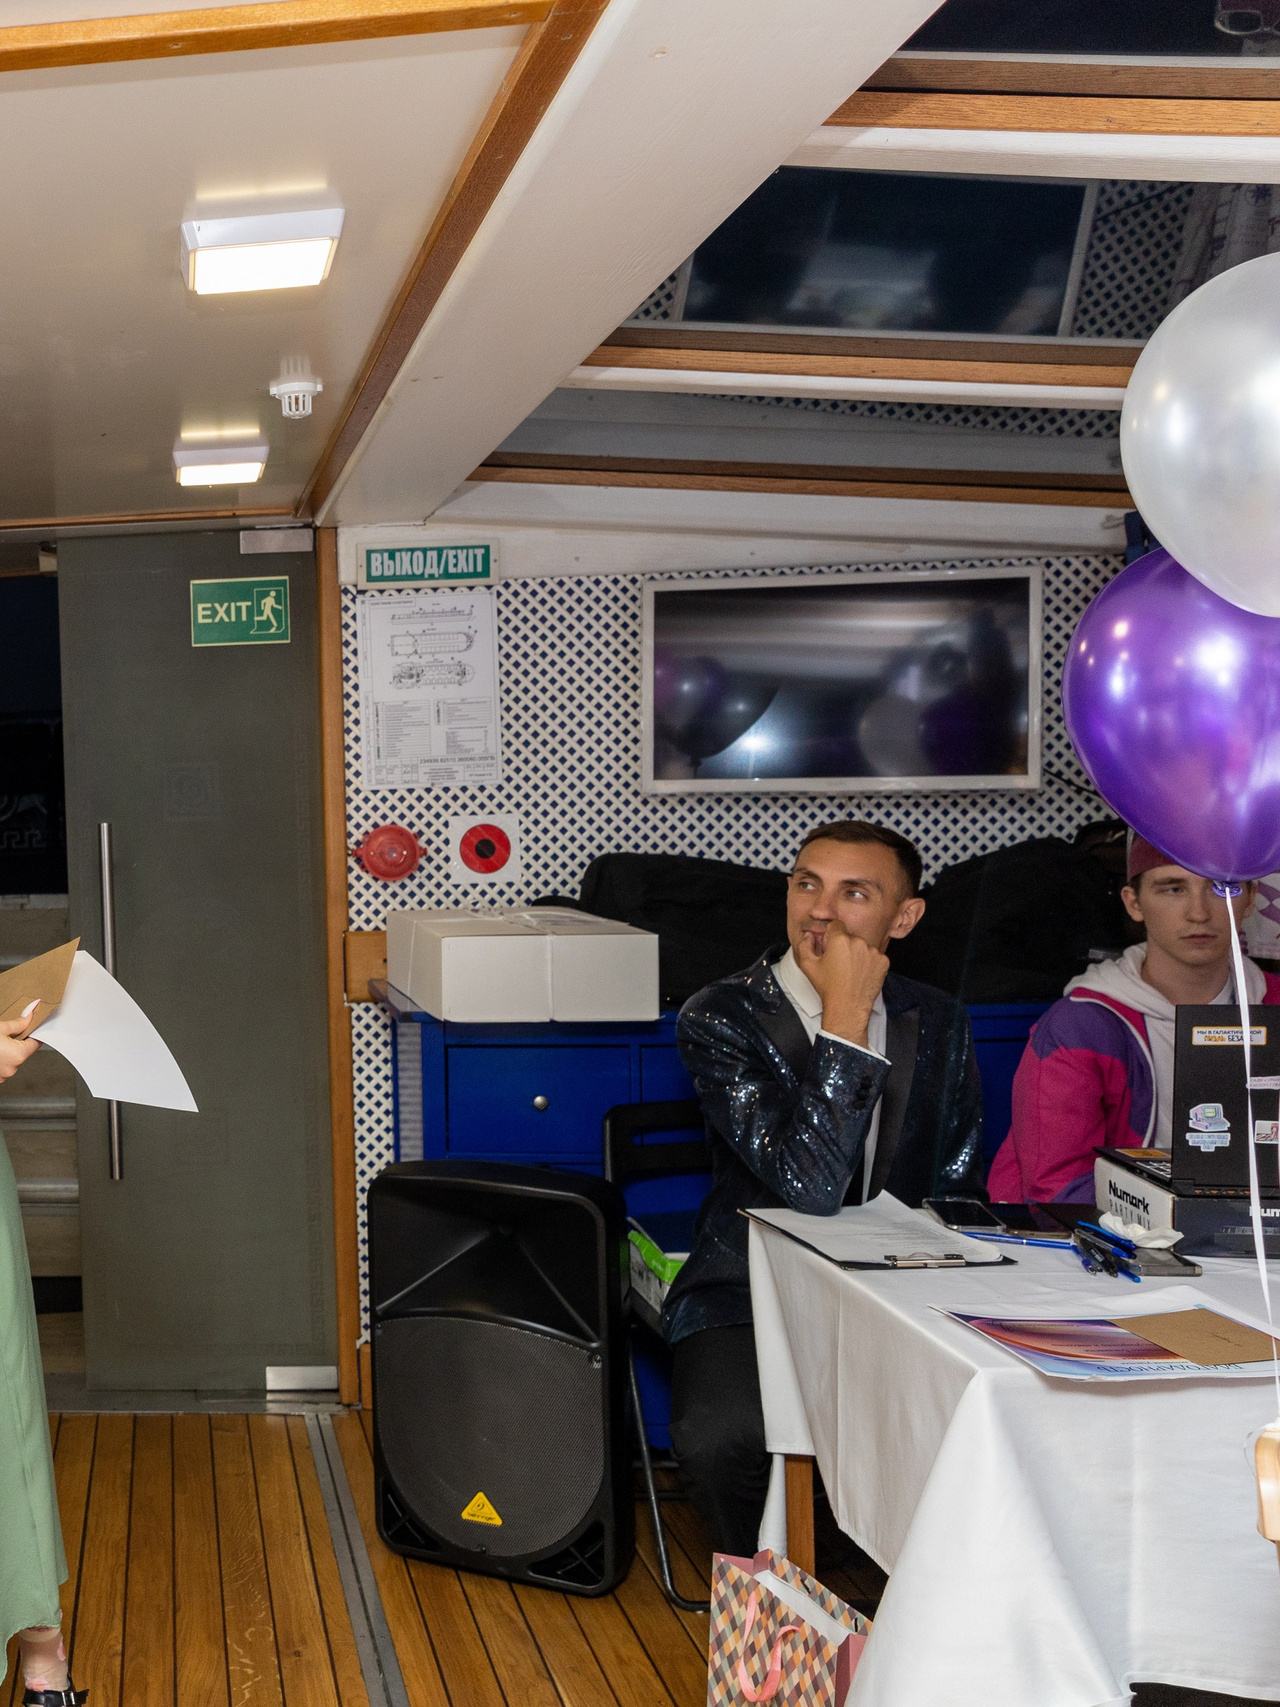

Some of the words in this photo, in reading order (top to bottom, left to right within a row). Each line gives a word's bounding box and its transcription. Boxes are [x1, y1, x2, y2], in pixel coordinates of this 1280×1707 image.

[370, 548, 485, 579] ВЫХОД/EXIT
[197, 601, 252, 625] EXIT
[1108, 1179, 1151, 1216] Numark
[1249, 1205, 1280, 1217] um
[1109, 1198, 1133, 1222] PARTY
[1136, 1213, 1151, 1231] MIX
